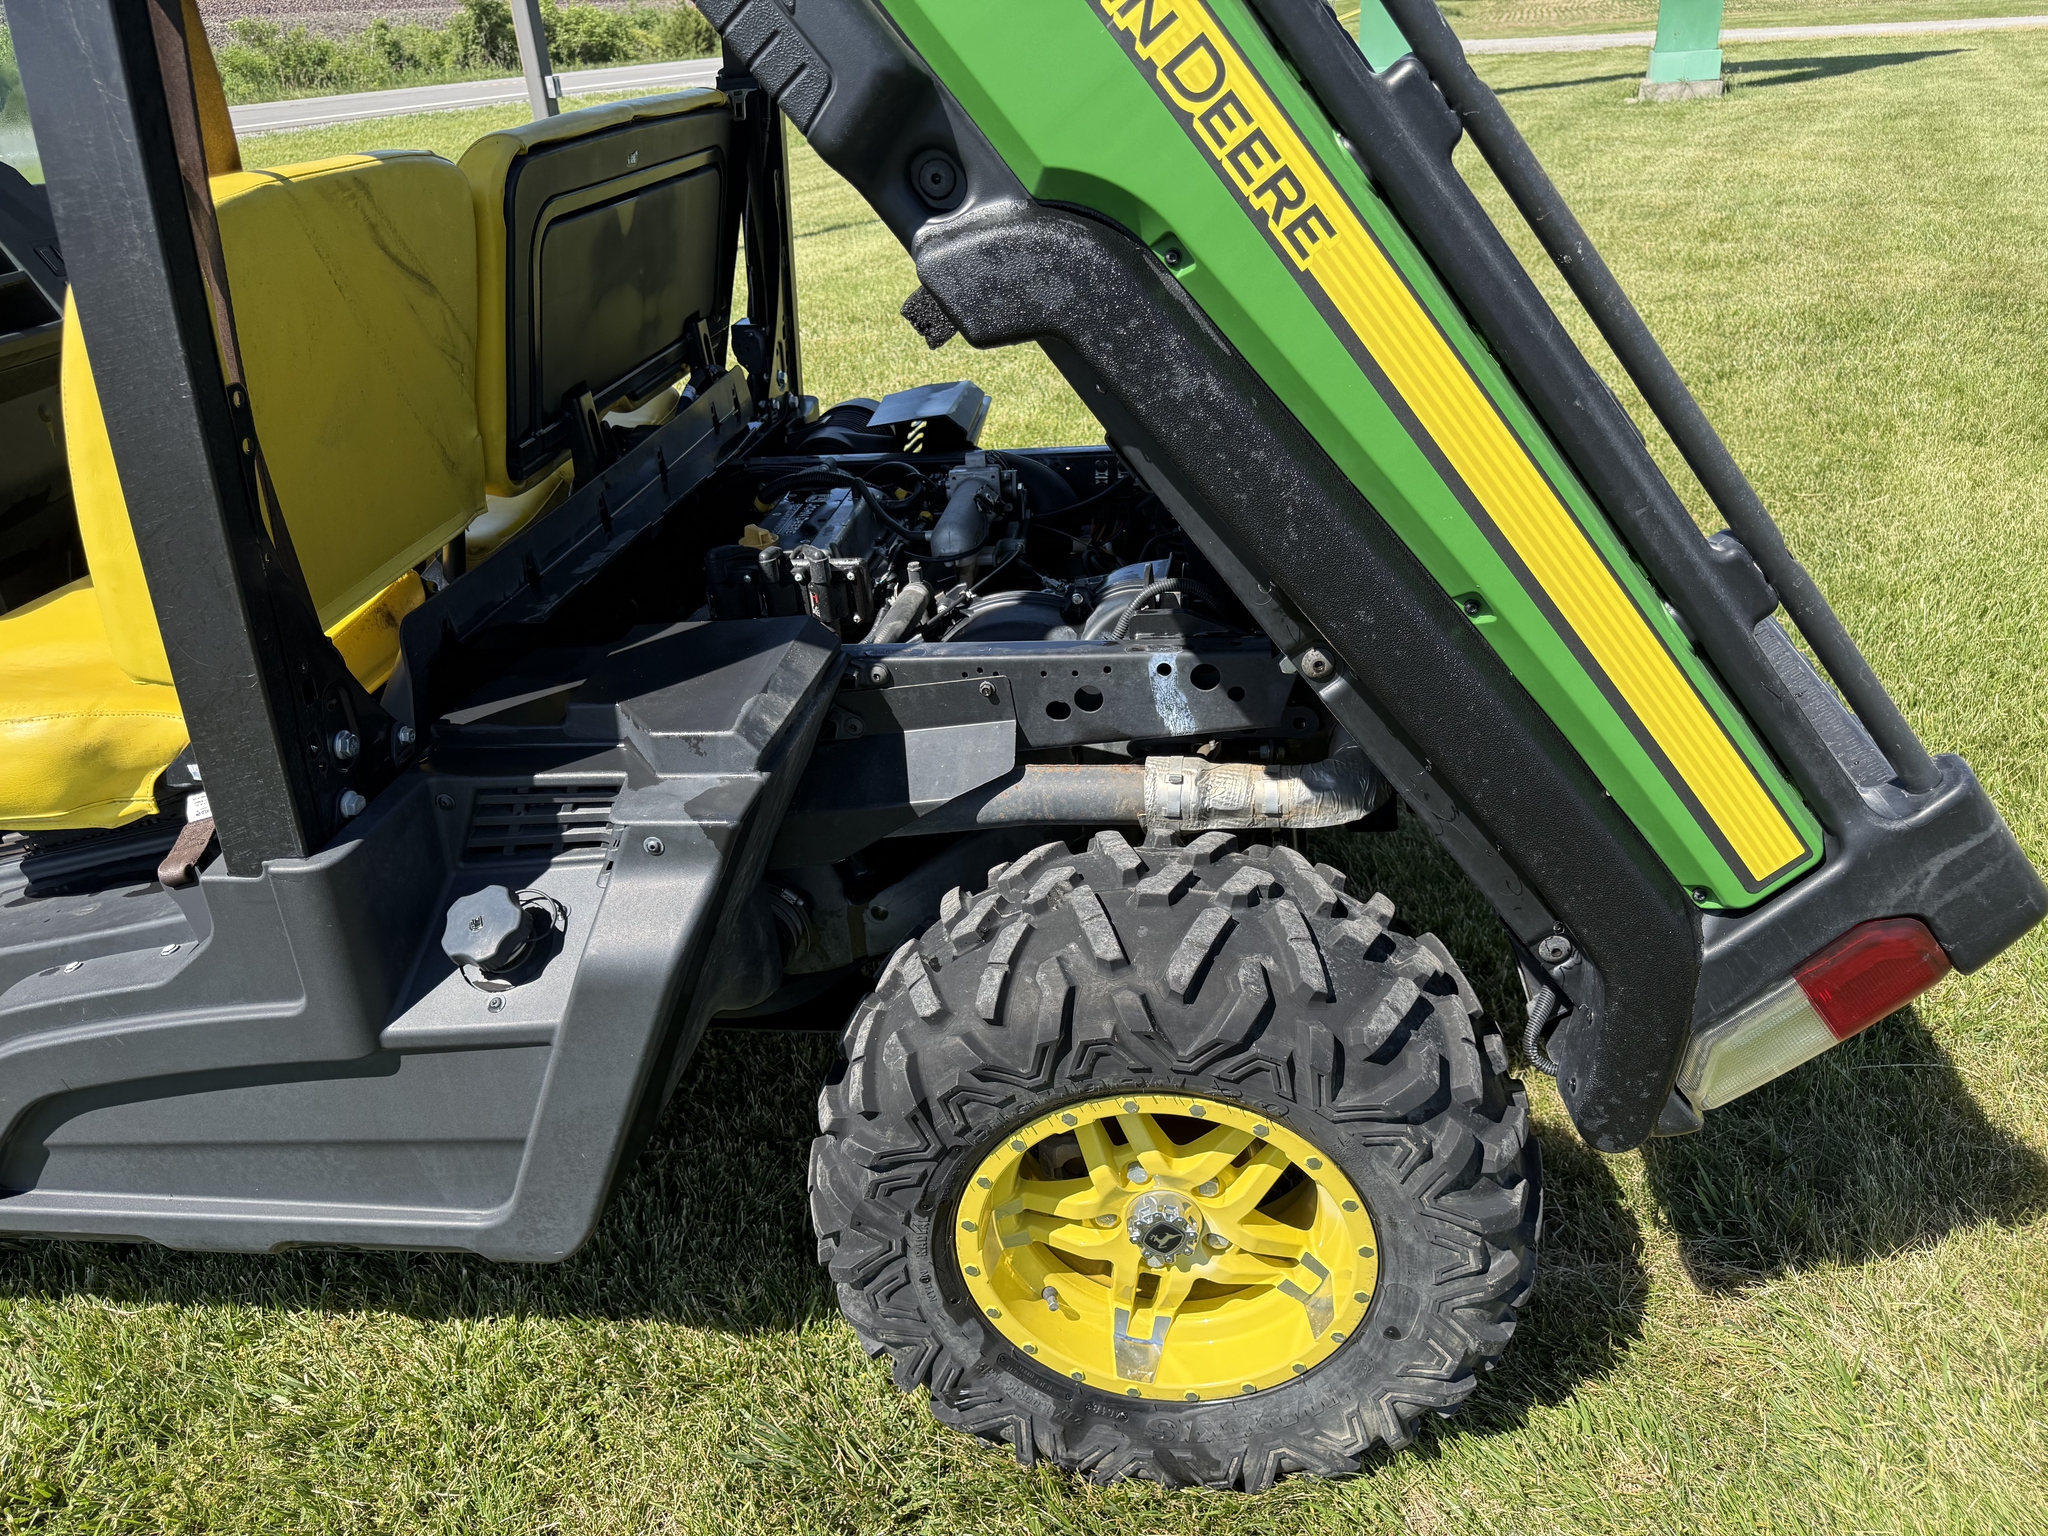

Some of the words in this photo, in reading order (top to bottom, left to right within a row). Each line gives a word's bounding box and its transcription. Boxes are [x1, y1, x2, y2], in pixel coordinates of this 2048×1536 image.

[1160, 31, 1339, 263] DEERE
[915, 1215, 931, 1257] RADIAL
[918, 1270, 937, 1303] NYLON
[1146, 1383, 1340, 1443] MAXXIS
